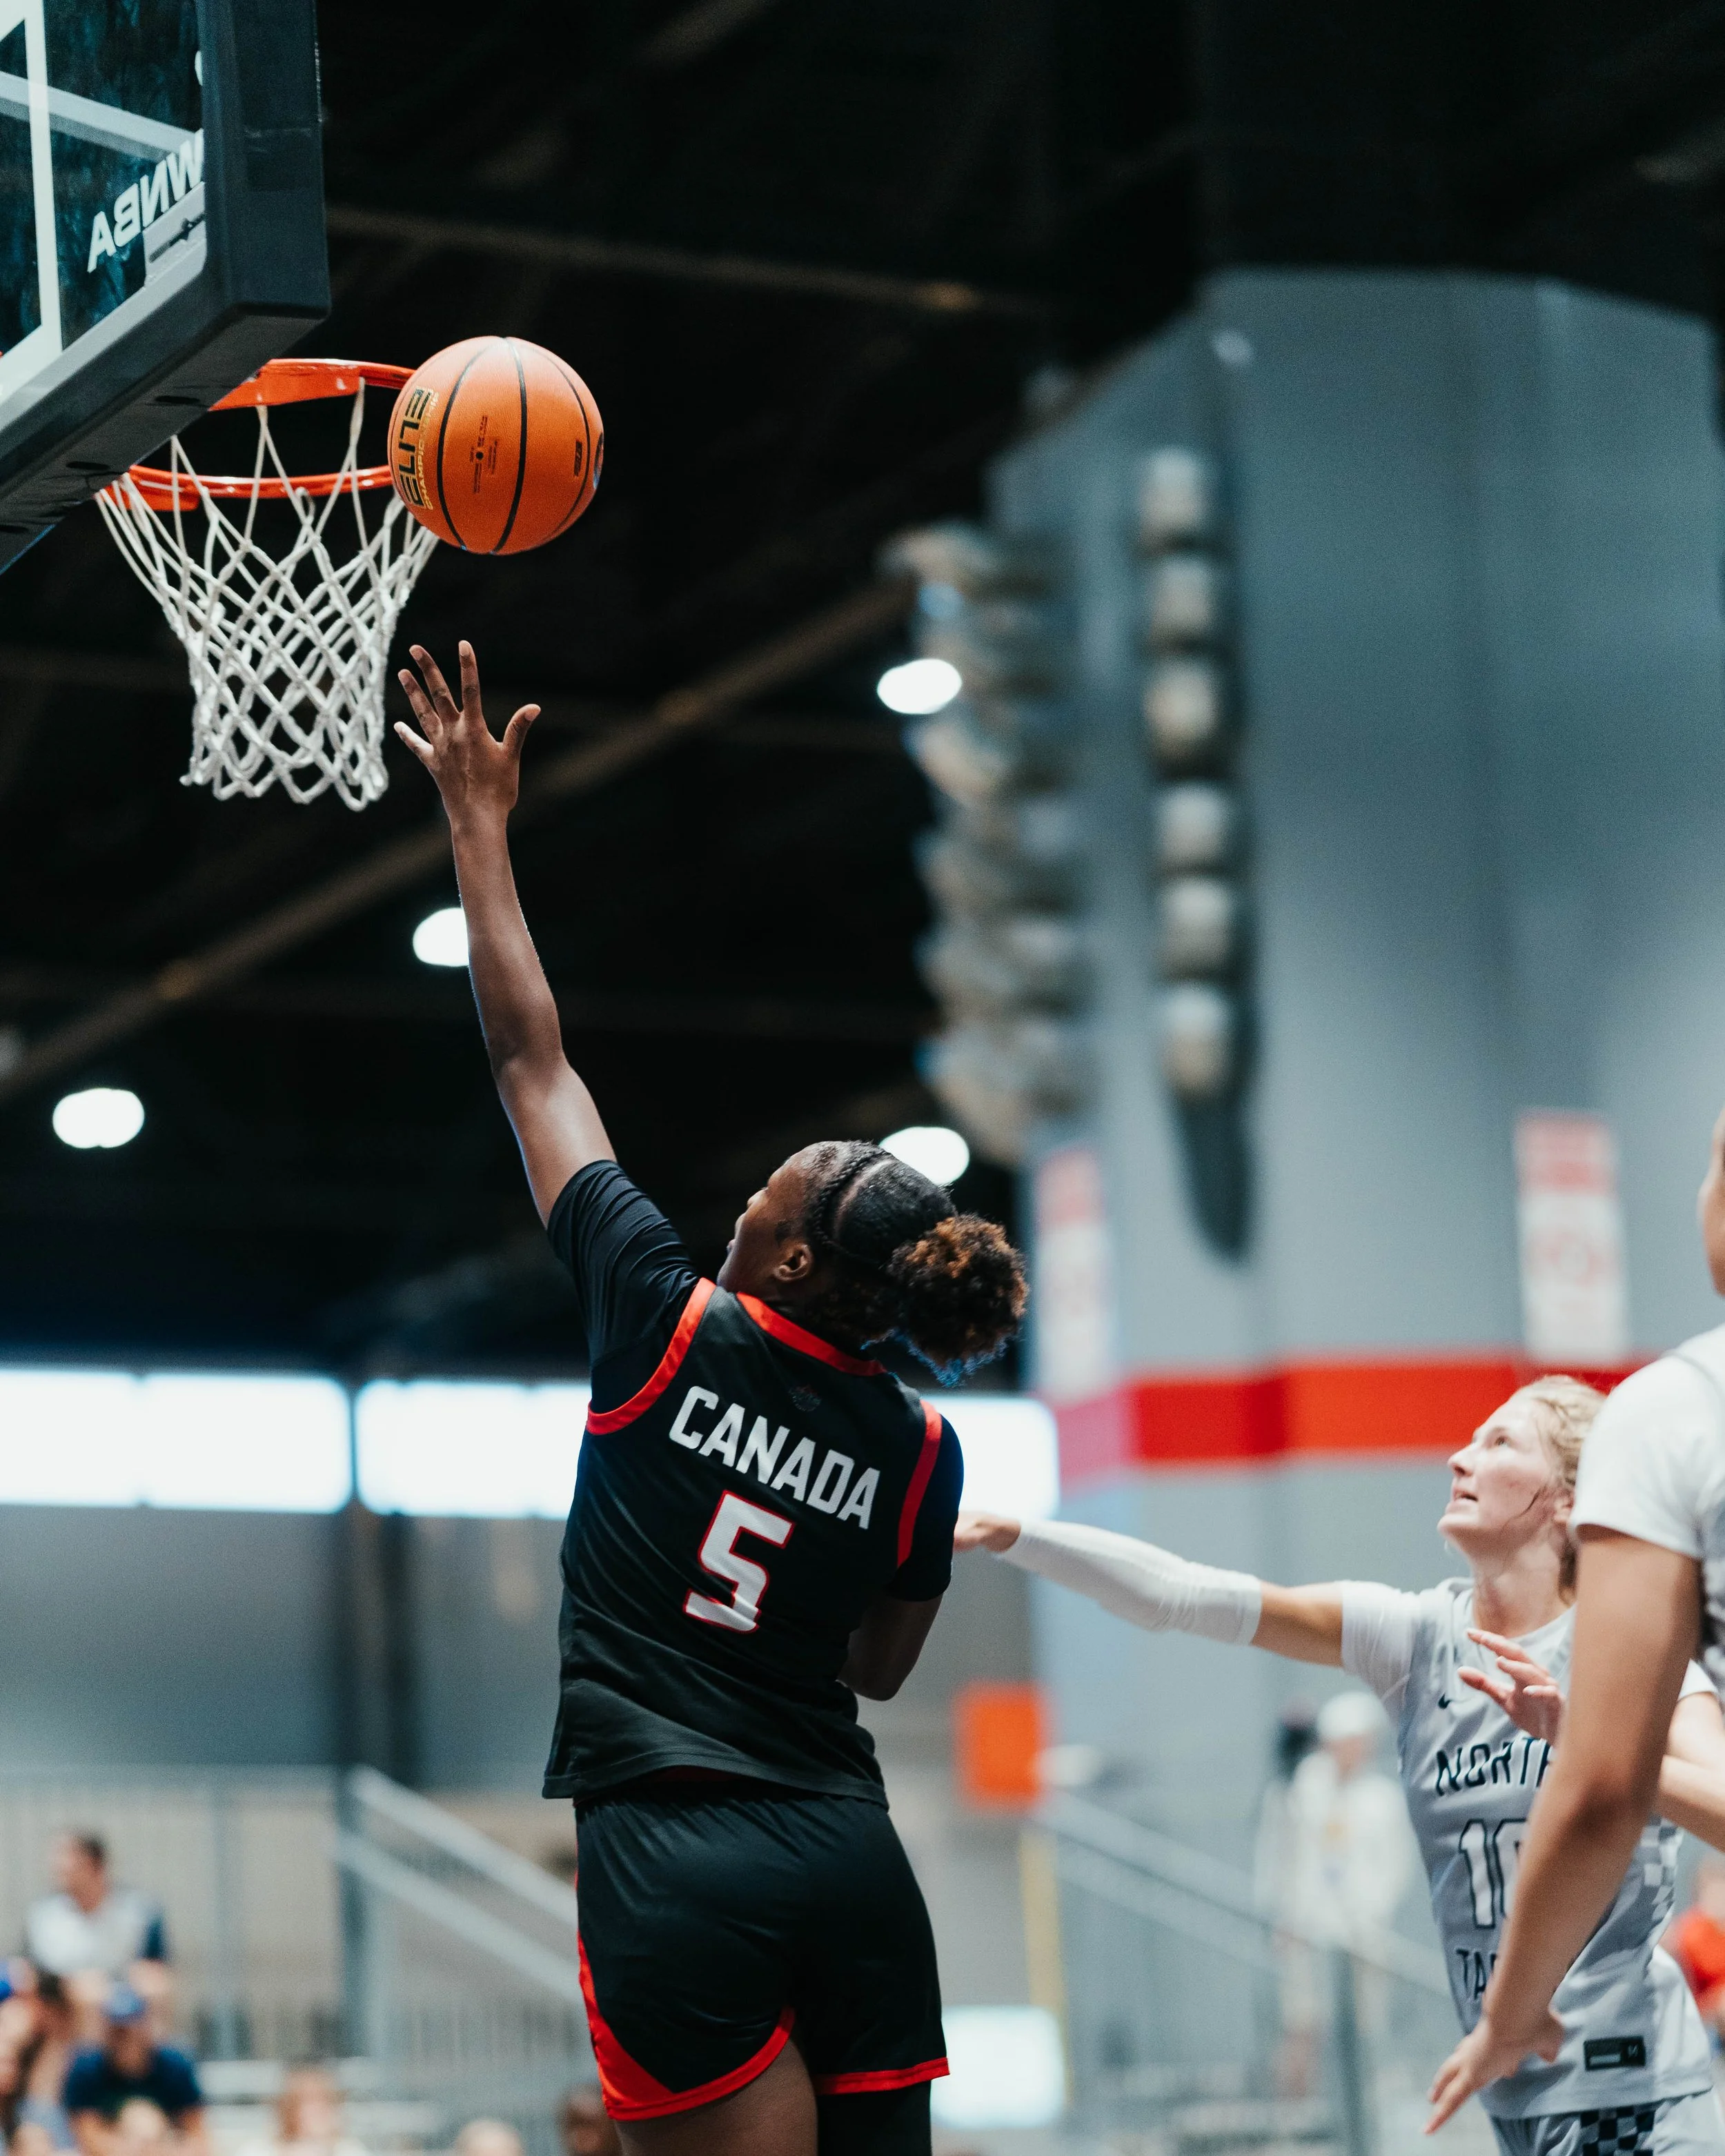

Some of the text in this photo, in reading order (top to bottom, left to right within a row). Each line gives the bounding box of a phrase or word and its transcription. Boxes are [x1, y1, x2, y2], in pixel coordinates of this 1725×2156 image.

[397, 386, 433, 508] ELITE
[417, 390, 440, 511] CHAMPIOHIP
[669, 1385, 881, 1530] CANADA
[682, 1489, 796, 1634] 5
